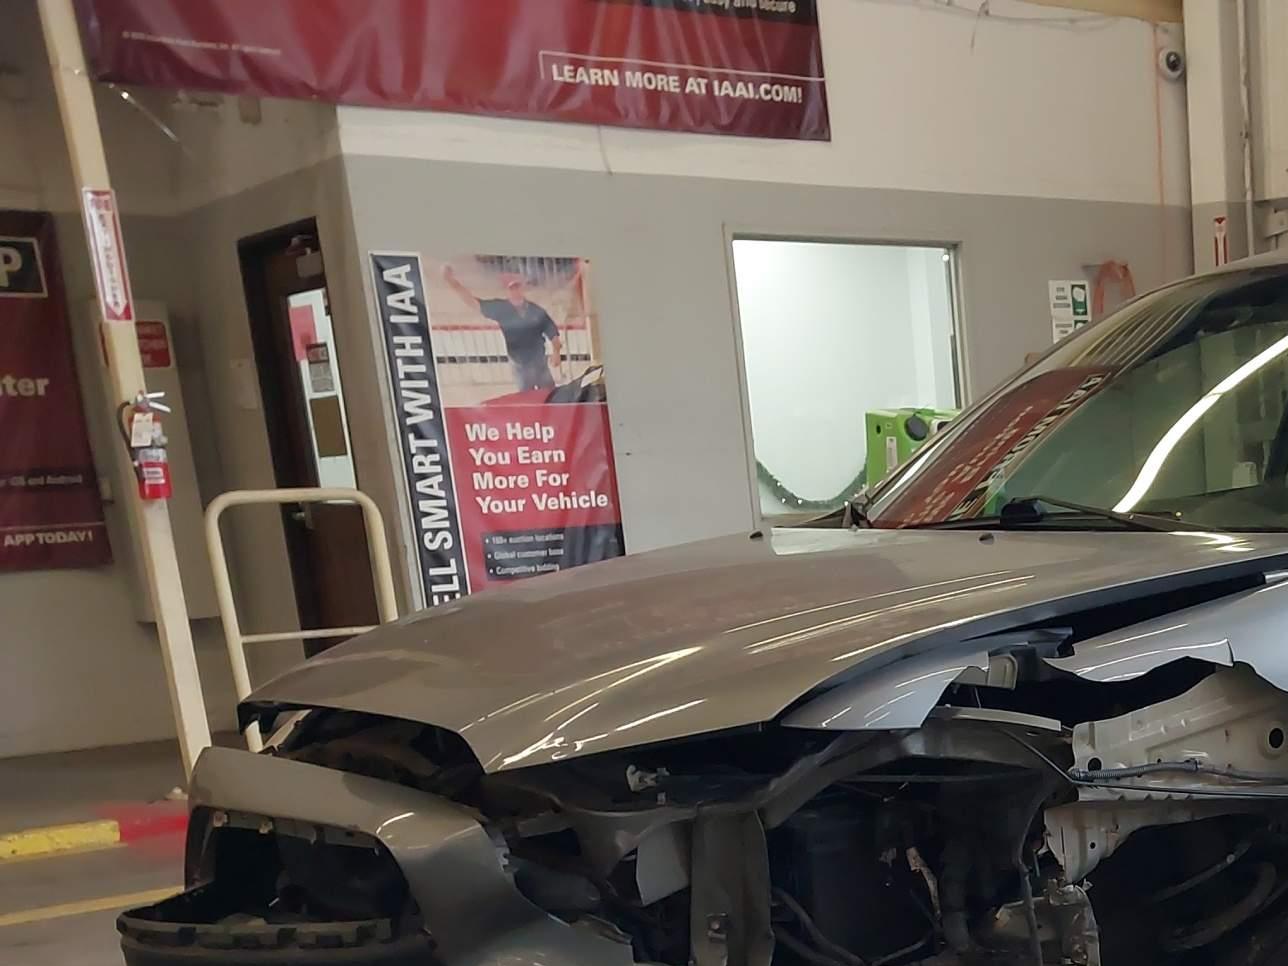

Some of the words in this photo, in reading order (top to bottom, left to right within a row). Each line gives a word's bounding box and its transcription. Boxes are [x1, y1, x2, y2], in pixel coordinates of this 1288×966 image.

[552, 64, 619, 86] LEARN
[625, 71, 680, 92] MORE
[685, 77, 707, 95] AT
[714, 81, 802, 103] IAAI.COM!
[383, 264, 420, 323] IAA
[0, 375, 49, 396] ter
[394, 335, 433, 425] WITH
[465, 424, 499, 442] We
[506, 422, 555, 443] Help
[469, 448, 510, 466] You
[517, 447, 566, 464] Earn
[411, 433, 453, 550] SMART
[472, 472, 529, 490] More
[536, 470, 570, 487] For
[476, 496, 526, 514] Your
[532, 490, 609, 511] Vehicle
[4, 533, 35, 547] APP
[35, 530, 93, 545] TODAY!
[428, 558, 461, 606] LL
